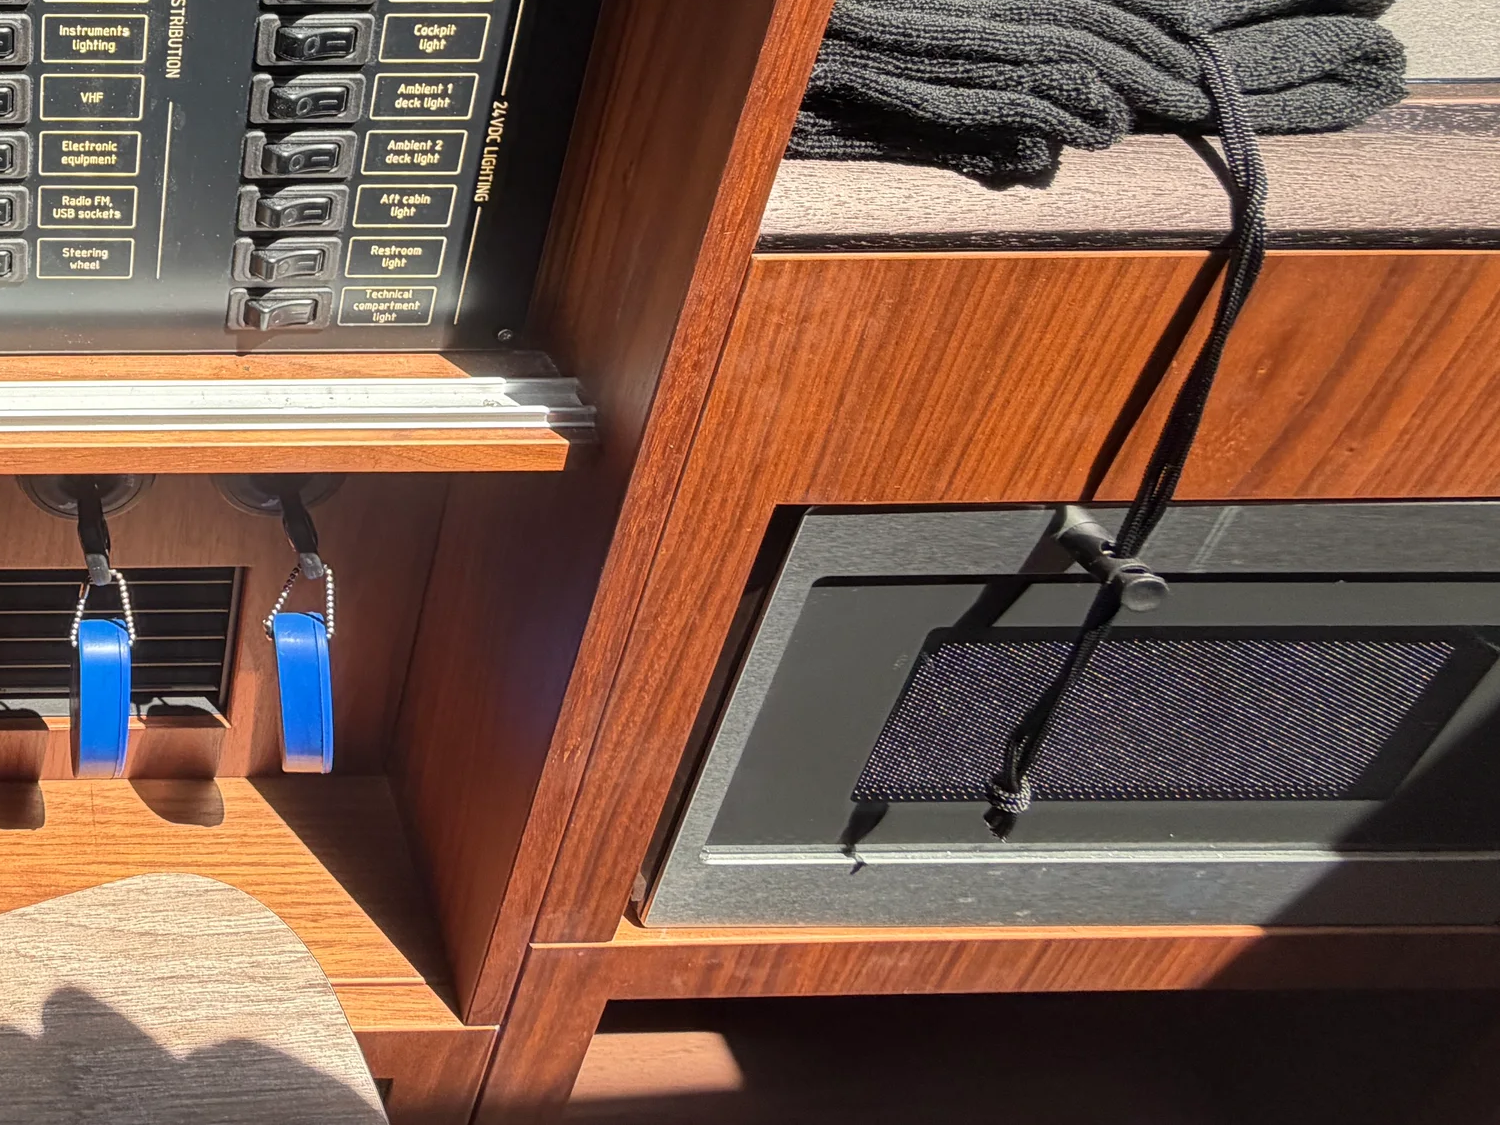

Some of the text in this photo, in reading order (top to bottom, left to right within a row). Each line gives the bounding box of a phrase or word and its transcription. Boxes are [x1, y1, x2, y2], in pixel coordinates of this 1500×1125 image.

[59, 25, 130, 37] Instruments
[414, 24, 456, 37] Cockpit
[72, 38, 116, 53] lighting
[419, 38, 446, 51] light
[397, 83, 453, 94] Ambient 1
[80, 92, 103, 104] VHF
[395, 97, 450, 110] deck light
[61, 140, 117, 152] Electronic
[387, 140, 443, 151] Ambient 2
[474, 101, 508, 202] 24VDC LIGHTING
[61, 154, 117, 166] equipment
[385, 153, 439, 165] deck light
[62, 196, 92, 207] Radio
[380, 193, 431, 204] Aft cabin
[52, 208, 121, 219] USB sockets
[390, 206, 416, 218] light
[62, 247, 108, 260] Steering
[371, 245, 422, 256] Restroom
[69, 260, 100, 270] wheel
[381, 257, 407, 269] light
[365, 289, 412, 300] Technical
[353, 301, 420, 312] compartment
[372, 311, 396, 322] light
